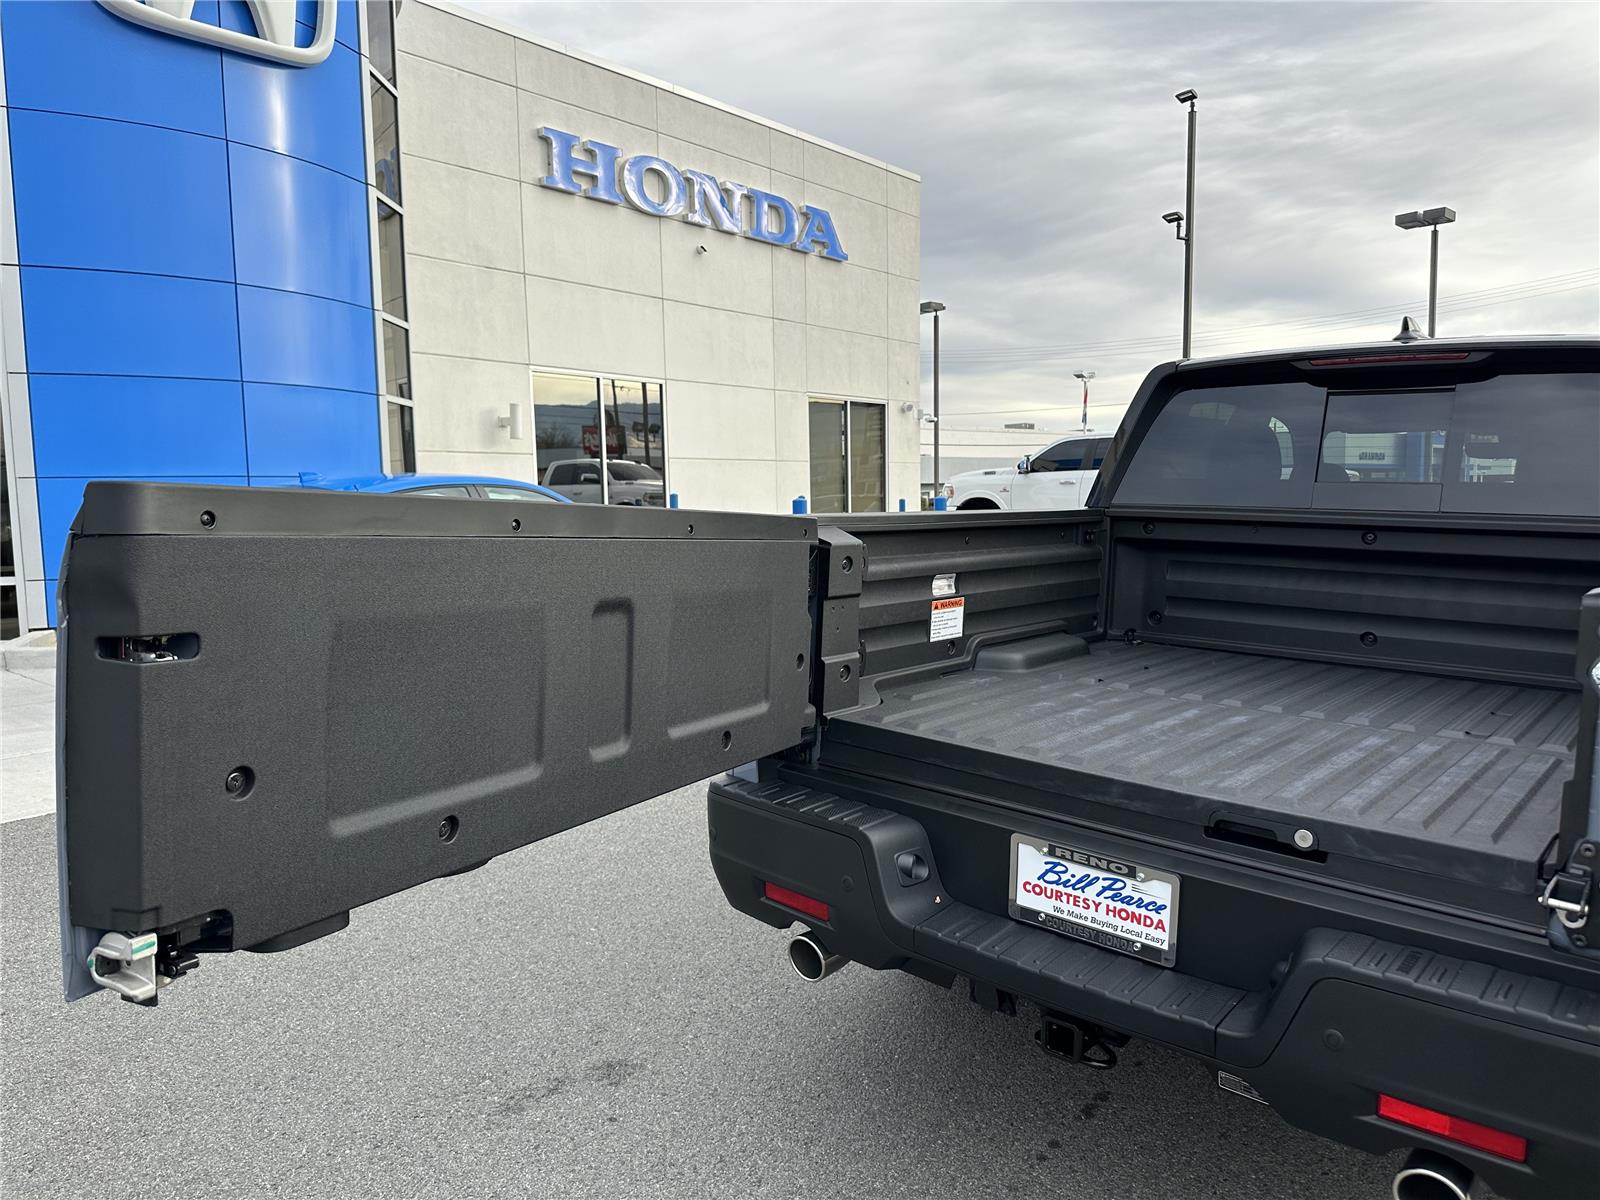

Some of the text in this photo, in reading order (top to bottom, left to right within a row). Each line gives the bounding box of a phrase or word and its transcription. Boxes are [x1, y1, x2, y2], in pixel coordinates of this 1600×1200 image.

[537, 126, 848, 262] HONDA
[940, 599, 963, 609] WARNING
[1054, 847, 1129, 874] RENO
[1022, 881, 1167, 933] COURTESY HONDA
[1037, 861, 1168, 915] Bill Pearce
[1046, 916, 1134, 952] COURTESY HONDA
[1052, 905, 1166, 946] We Make Buying Local Easy
